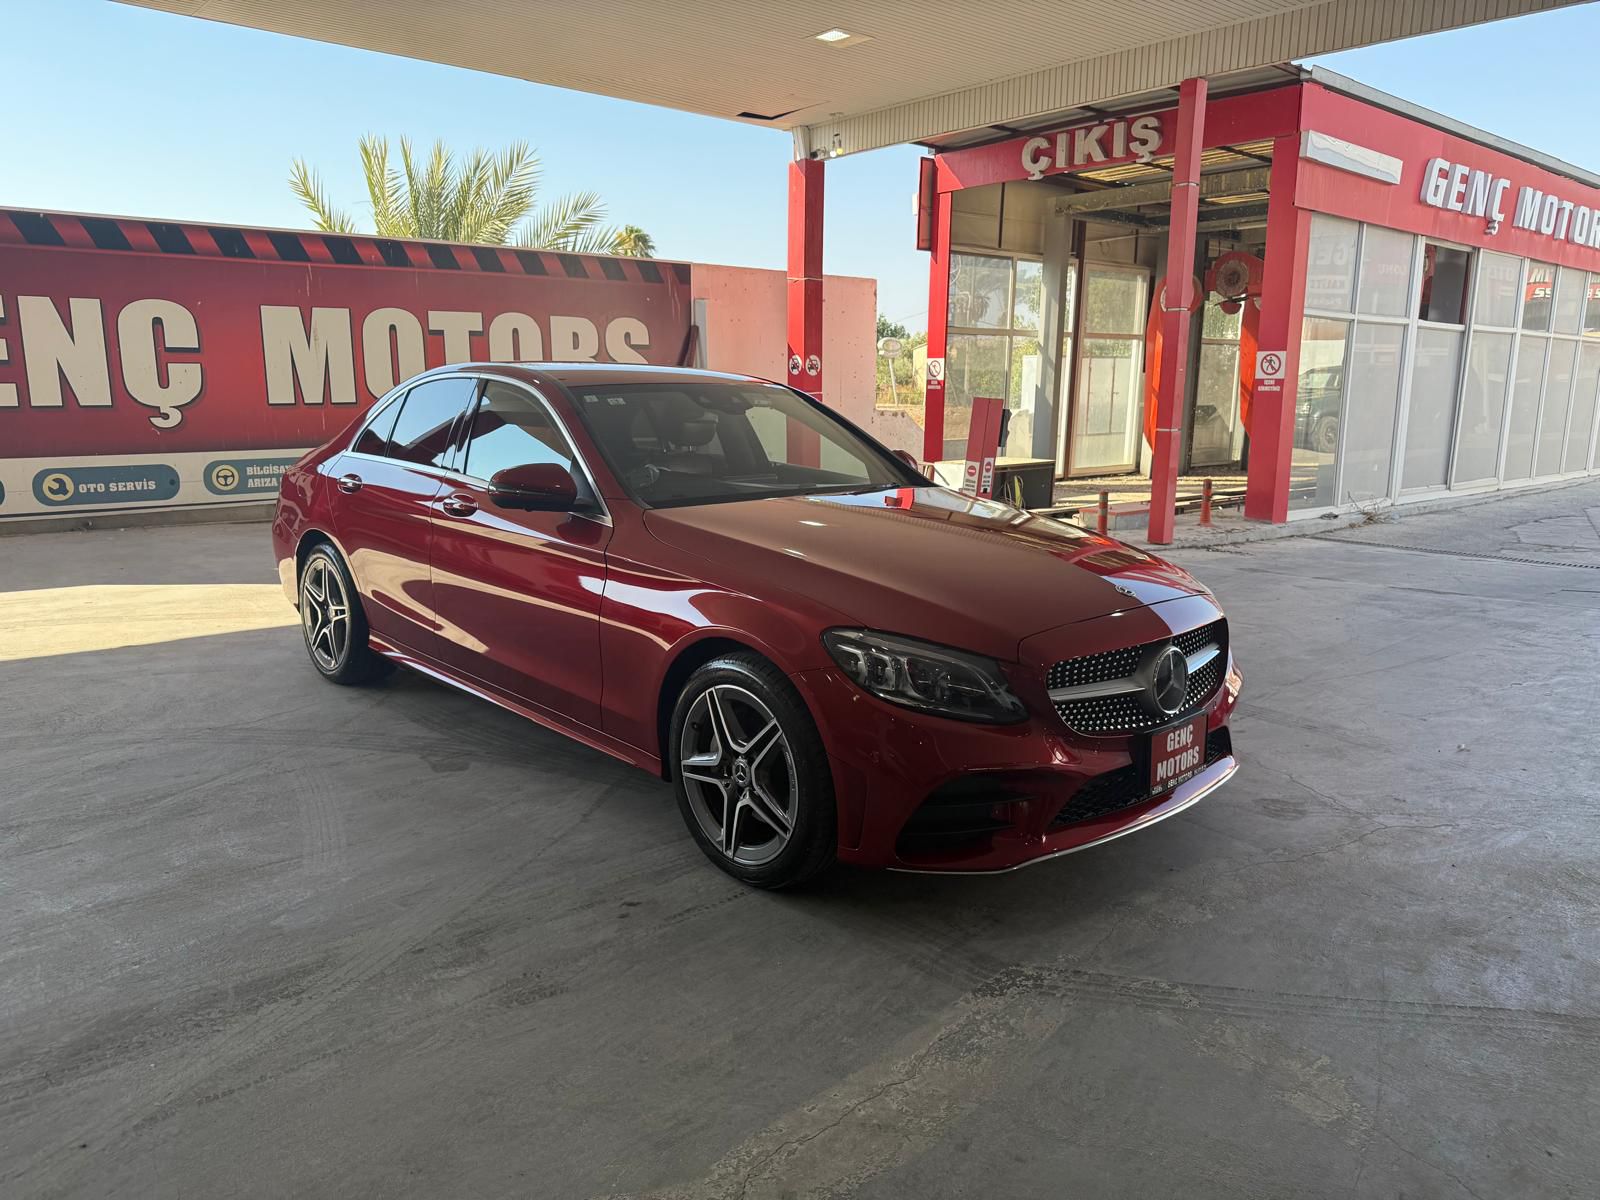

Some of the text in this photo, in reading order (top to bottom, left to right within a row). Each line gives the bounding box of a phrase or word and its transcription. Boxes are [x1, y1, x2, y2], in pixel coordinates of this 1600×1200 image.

[1021, 116, 1162, 181] ÇIKIŞ
[1421, 158, 1511, 236] GENÇ
[0, 295, 204, 428] NÇ
[78, 478, 157, 493] OTO SERVİS
[247, 477, 278, 488] ARIZA
[1167, 725, 1192, 751] GENÇ
[1157, 747, 1198, 781] MOTORS
